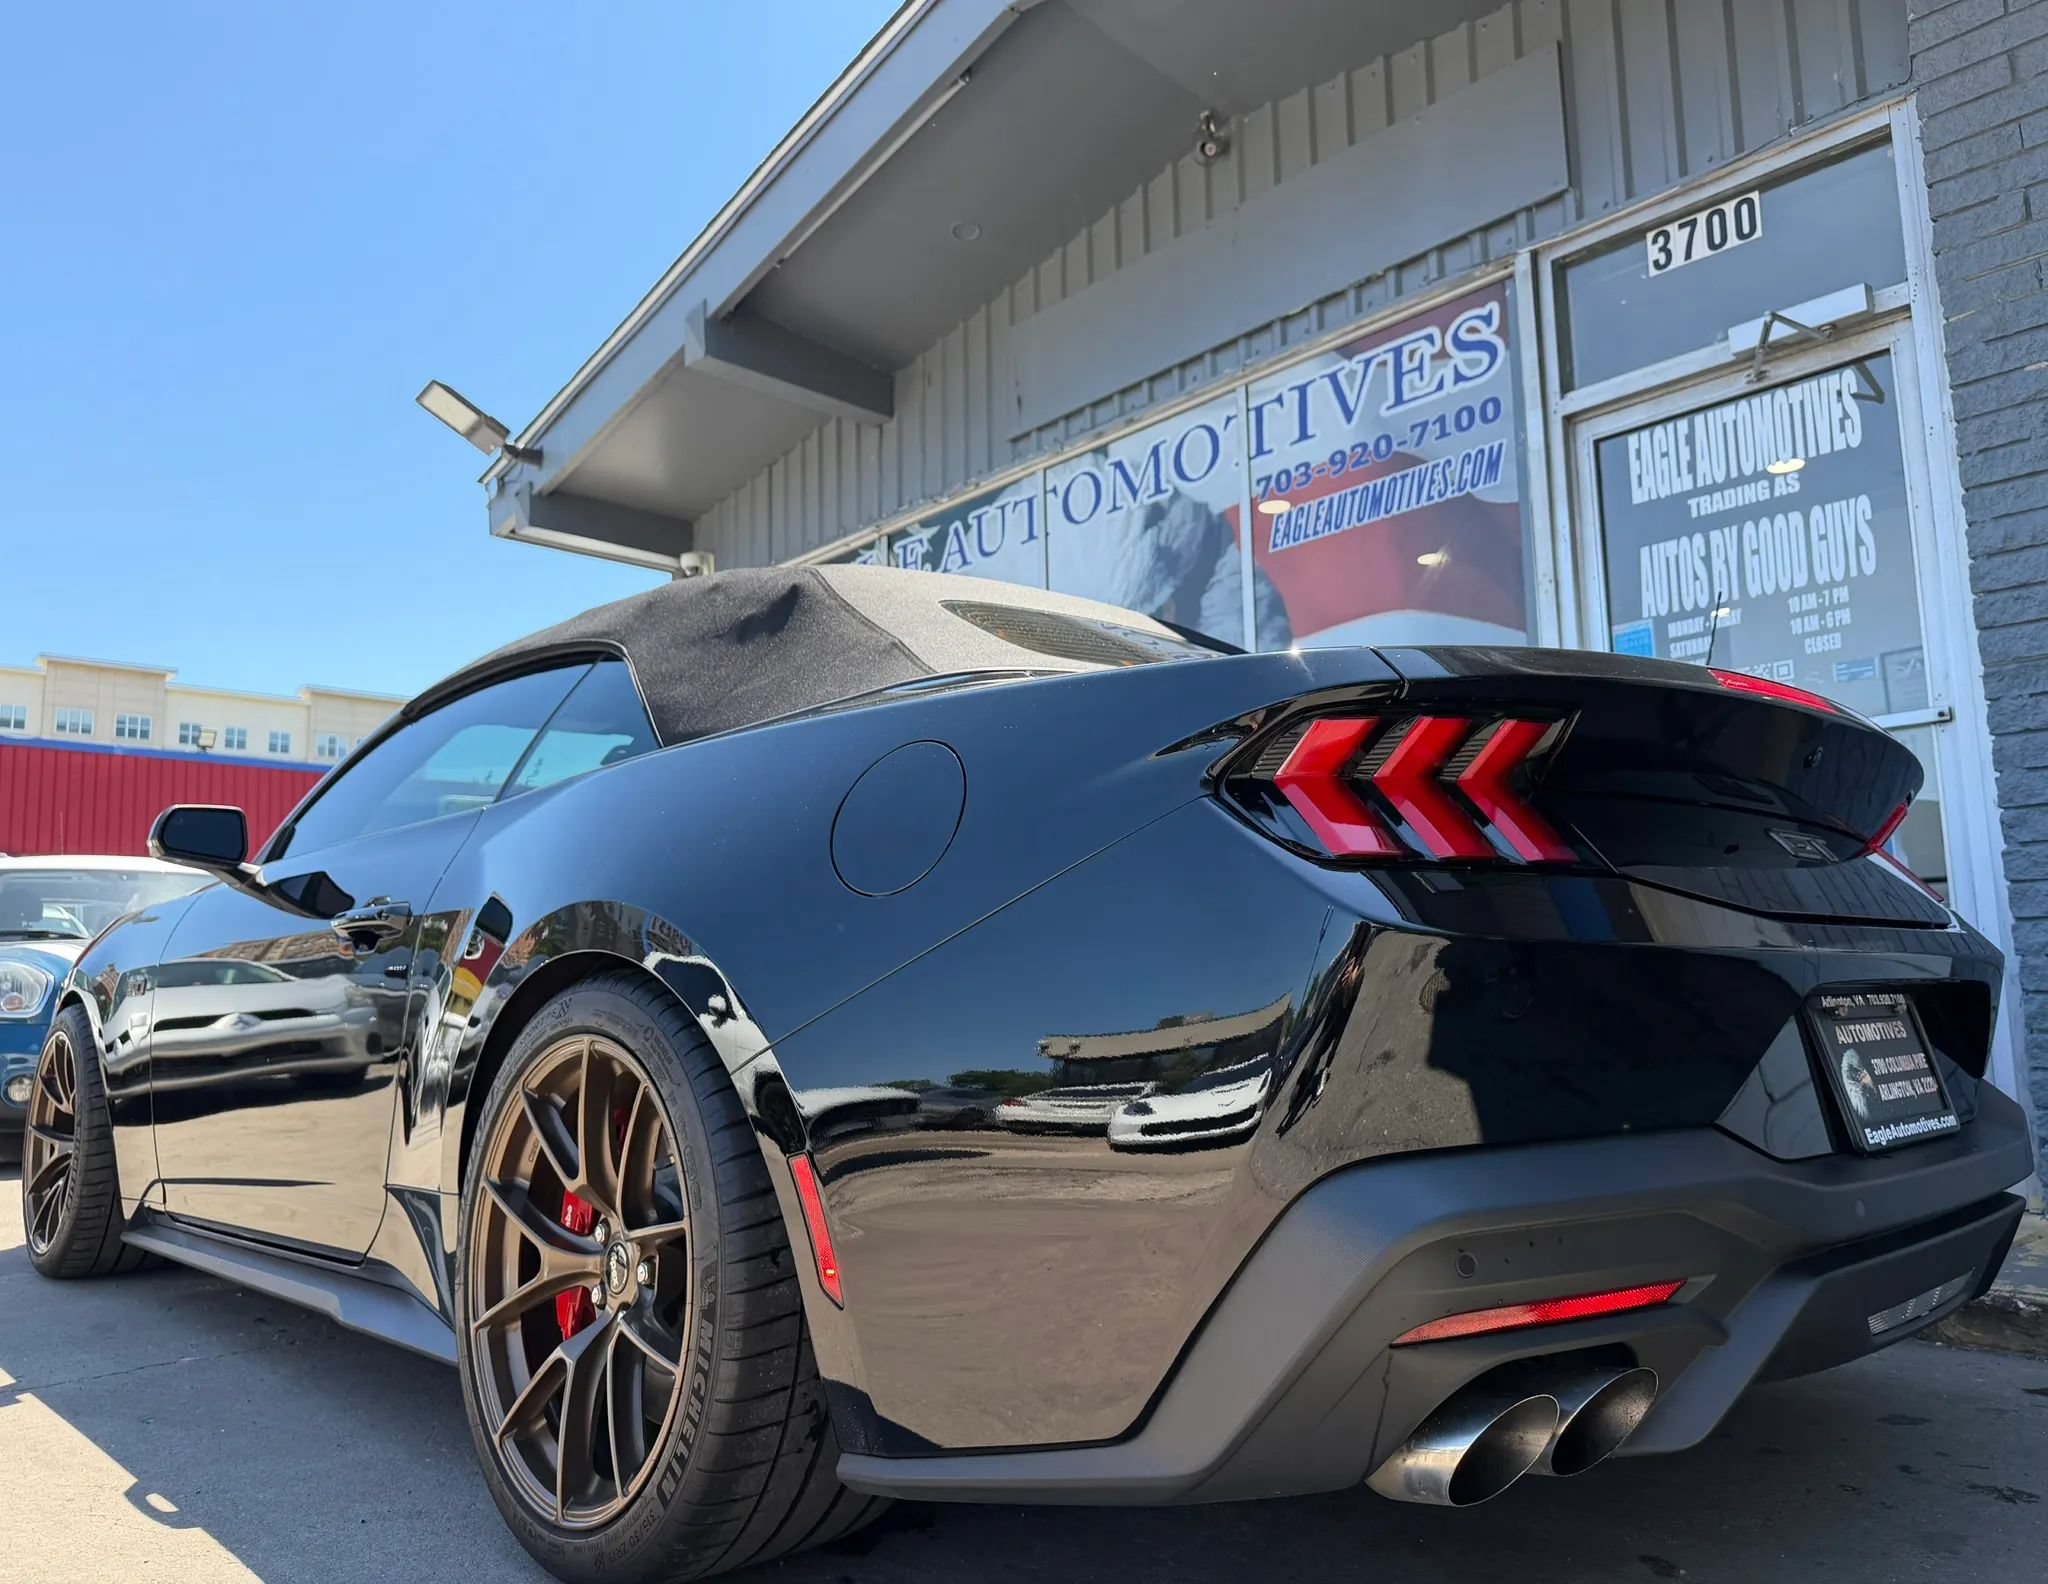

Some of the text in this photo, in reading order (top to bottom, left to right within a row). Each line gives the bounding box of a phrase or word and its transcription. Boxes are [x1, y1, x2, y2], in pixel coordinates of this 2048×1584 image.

[1650, 196, 1759, 271] 3700
[940, 304, 1502, 573] AUTOMOTIVES
[1255, 398, 1502, 500] 703-920-7100
[1627, 368, 1863, 505] EAGLE AUTOMOTIVES
[1270, 441, 1505, 552] EAGLEAUTOMOTIVES.COM
[1688, 473, 1801, 518] TRADING AS
[1639, 494, 1878, 619] AUTOS BY GOOD GUYS
[1832, 585, 1849, 605] PM
[1834, 607, 1851, 627] PM
[1804, 632, 1842, 654] CLOSED
[1835, 1020, 1908, 1045] AUTOMOTIVES
[1864, 1114, 1958, 1146] EagleAutomotives.com
[661, 1317, 714, 1501] MICHELIN
